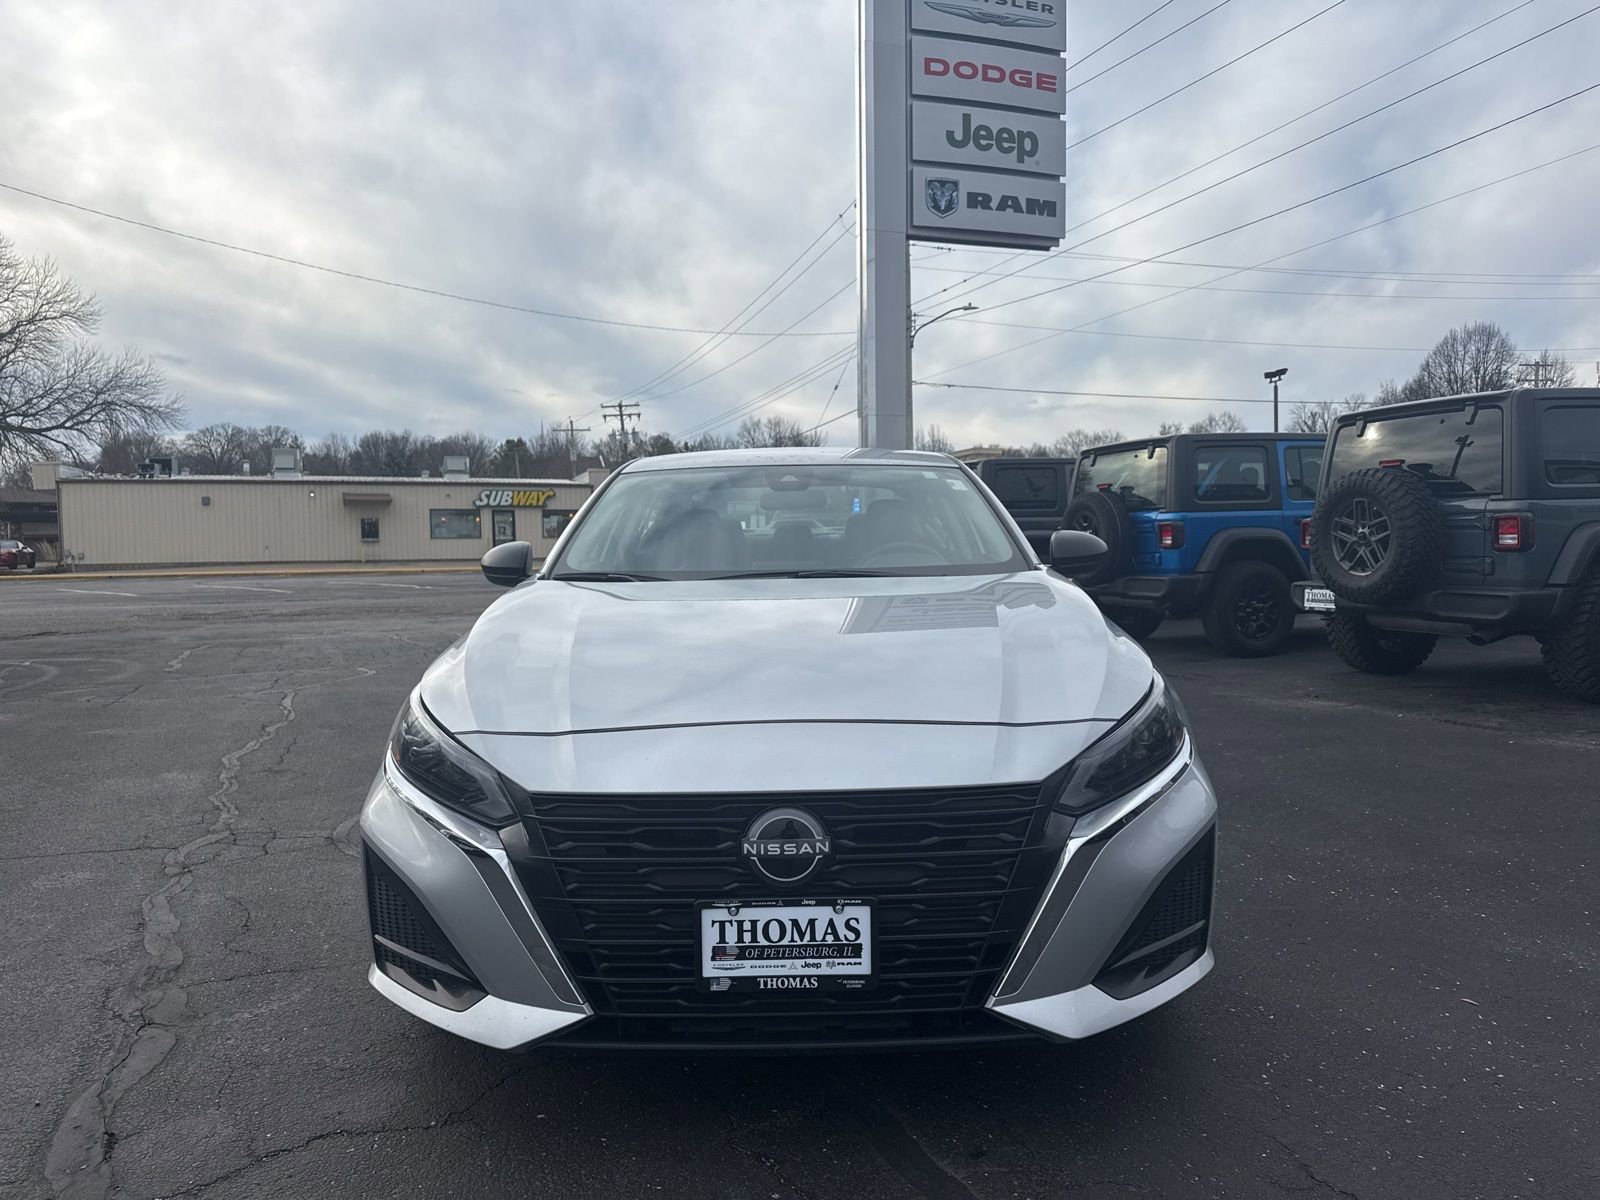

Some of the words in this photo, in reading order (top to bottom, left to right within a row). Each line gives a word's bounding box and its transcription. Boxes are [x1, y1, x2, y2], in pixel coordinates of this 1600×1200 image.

[924, 57, 1057, 93] DODGE
[946, 113, 1039, 164] Jeep
[966, 192, 1057, 218] RAM
[474, 489, 555, 507] SUBWAY
[743, 841, 829, 855] NISSAN
[711, 917, 861, 945] THOMAS
[745, 947, 762, 958] OF
[763, 946, 840, 958] PETERSBURG,
[843, 946, 854, 957] IL
[801, 960, 822, 970] Jeep
[757, 977, 818, 989] THOMAS
